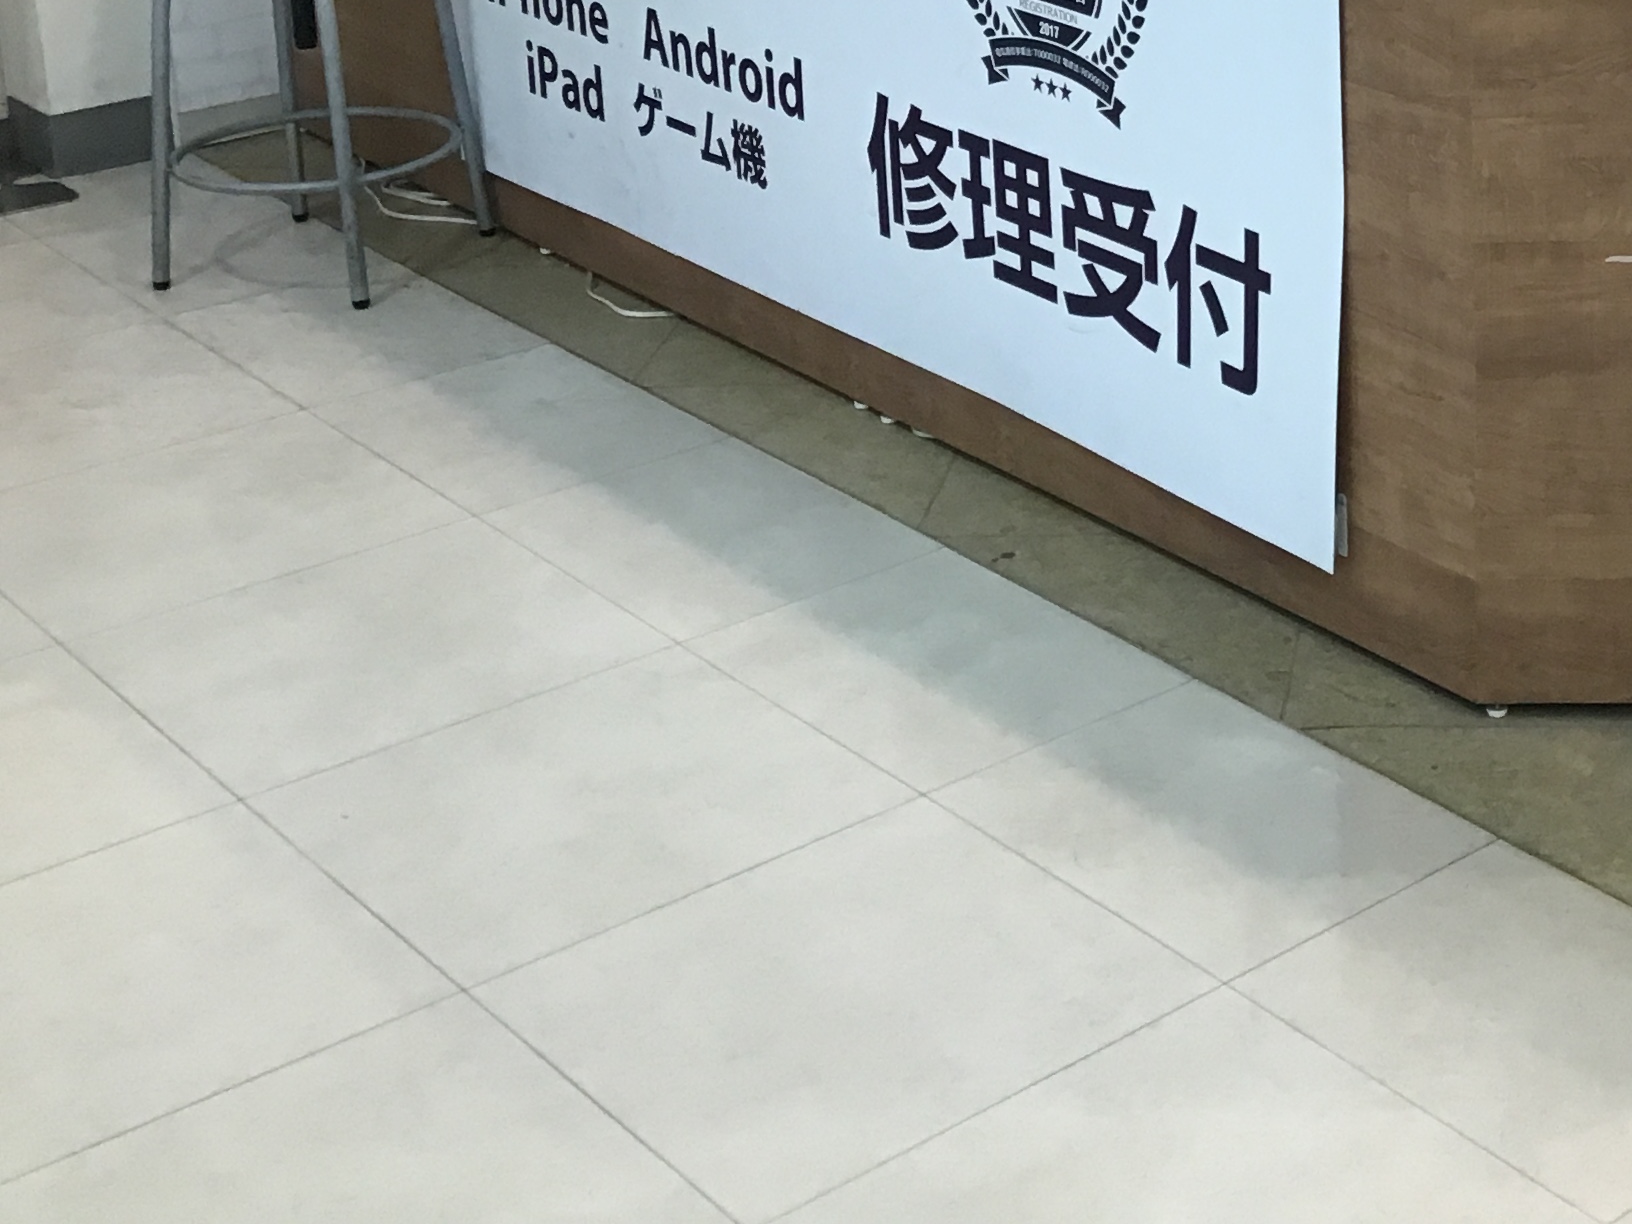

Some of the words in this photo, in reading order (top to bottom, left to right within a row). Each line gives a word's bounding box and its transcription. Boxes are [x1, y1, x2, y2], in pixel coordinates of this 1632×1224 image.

[643, 7, 805, 120] Android
[1039, 21, 1060, 39] 2017
[526, 40, 605, 121] iPad
[633, 82, 768, 190] ゲーム機
[867, 92, 1271, 396] 修理受付
